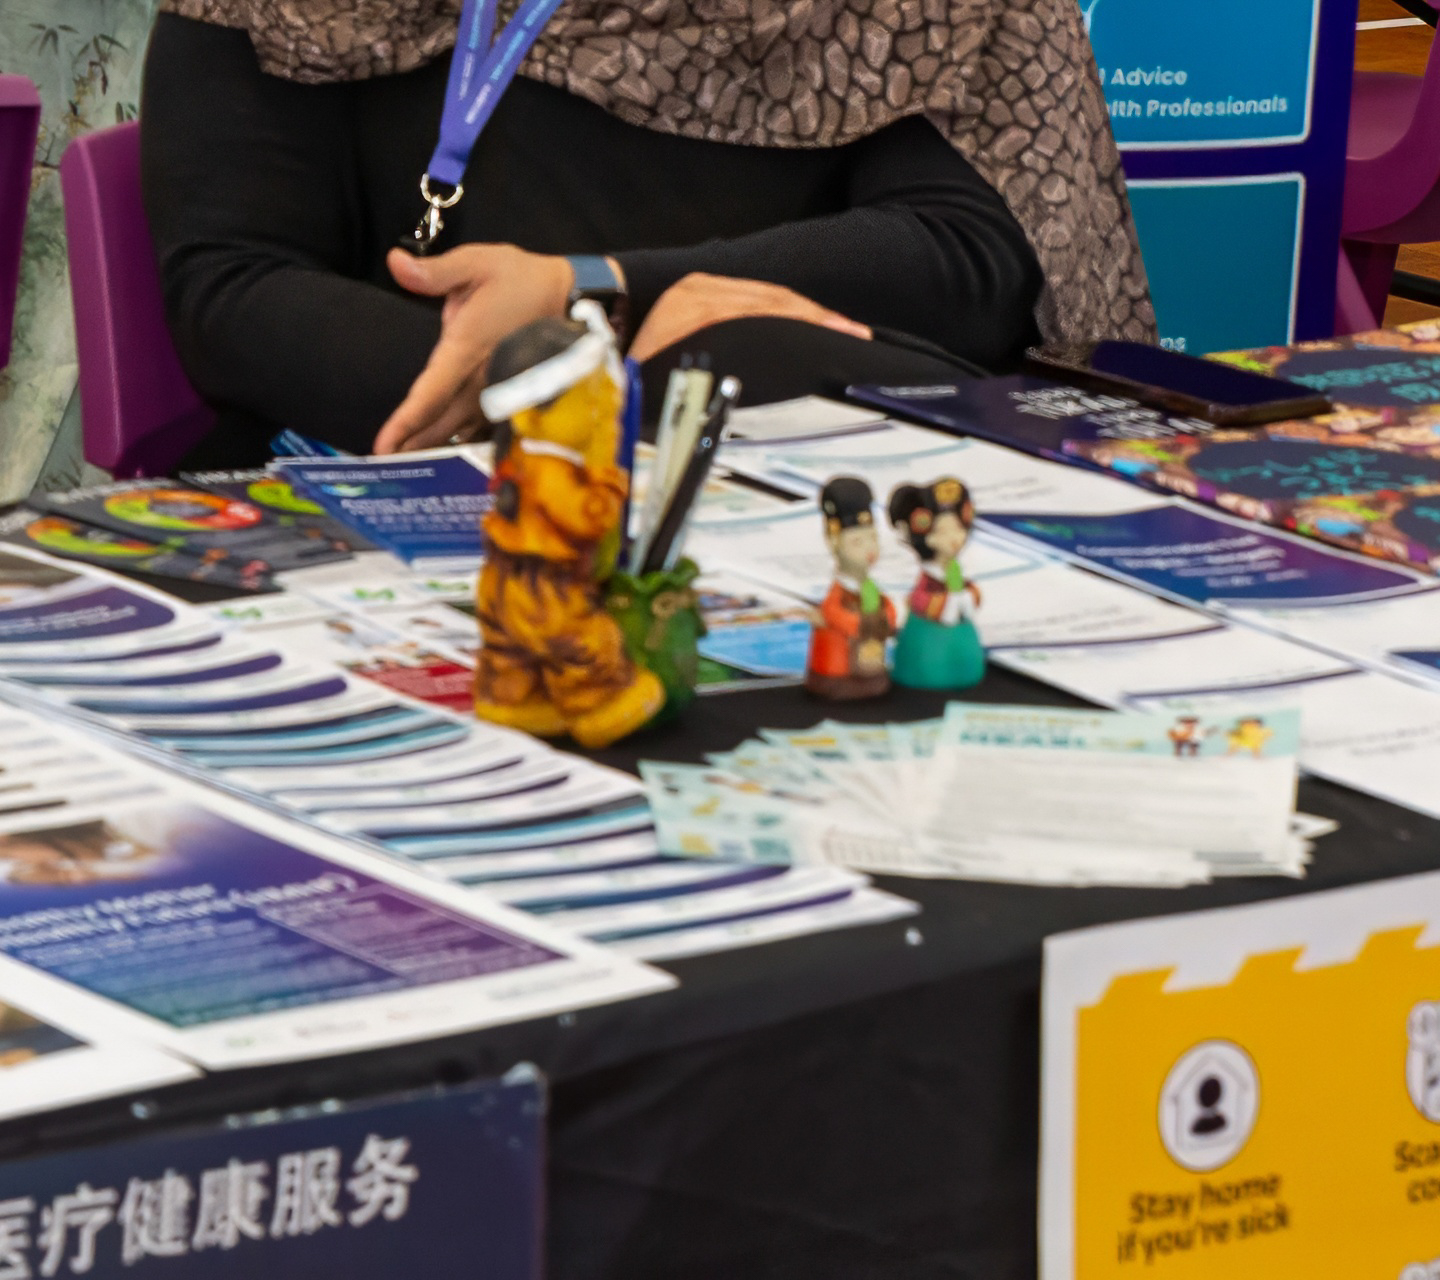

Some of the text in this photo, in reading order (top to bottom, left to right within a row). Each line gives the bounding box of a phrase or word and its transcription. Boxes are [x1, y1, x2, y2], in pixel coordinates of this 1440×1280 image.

[1111, 66, 1187, 87] Advice
[1146, 95, 1288, 118] Professionals
[1129, 1175, 1282, 1225] Stay home
[1141, 1203, 1290, 1266] you're sick
